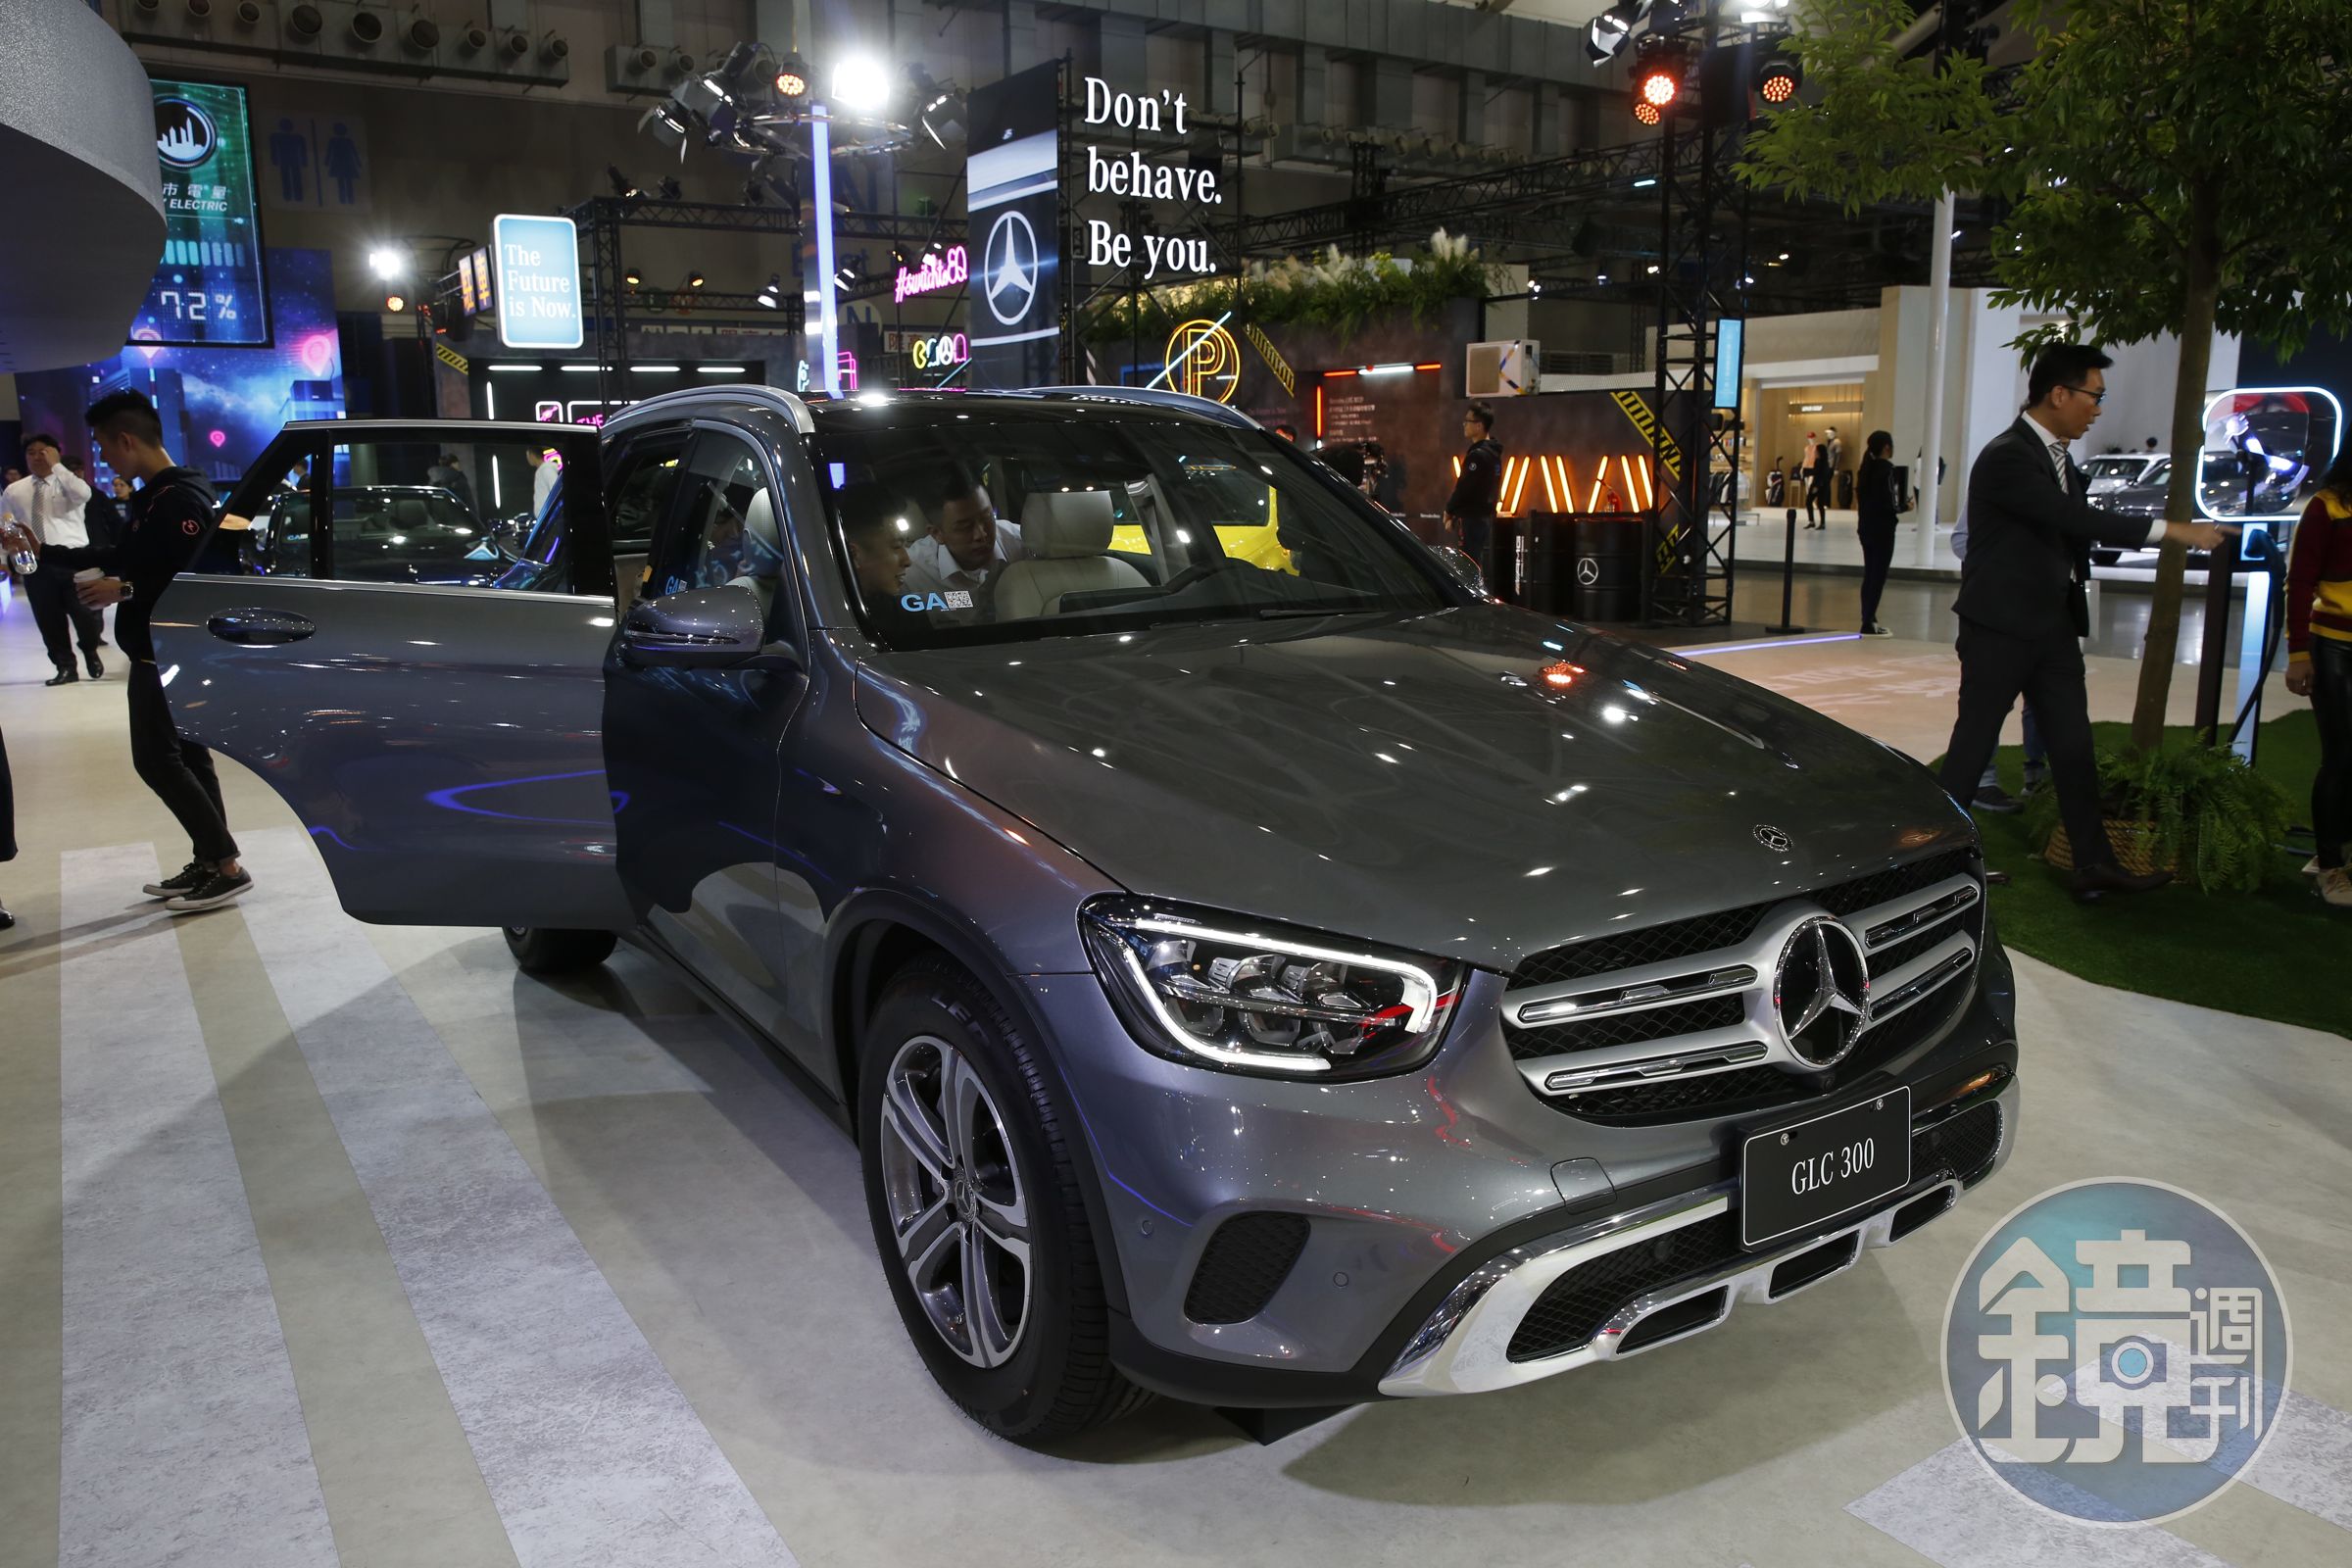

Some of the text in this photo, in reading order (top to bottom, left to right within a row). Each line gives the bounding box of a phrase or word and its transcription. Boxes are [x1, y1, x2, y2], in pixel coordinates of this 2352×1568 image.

[1085, 76, 1187, 134] Don't
[1087, 145, 1222, 204] behave.
[170, 198, 227, 212] ELECTRIC
[505, 244, 541, 267] The
[1088, 220, 1216, 280] Be you.
[507, 270, 570, 293] Future
[509, 296, 576, 318] is Now.
[901, 592, 949, 612] GA
[1791, 1137, 1875, 1195] GLC 300
